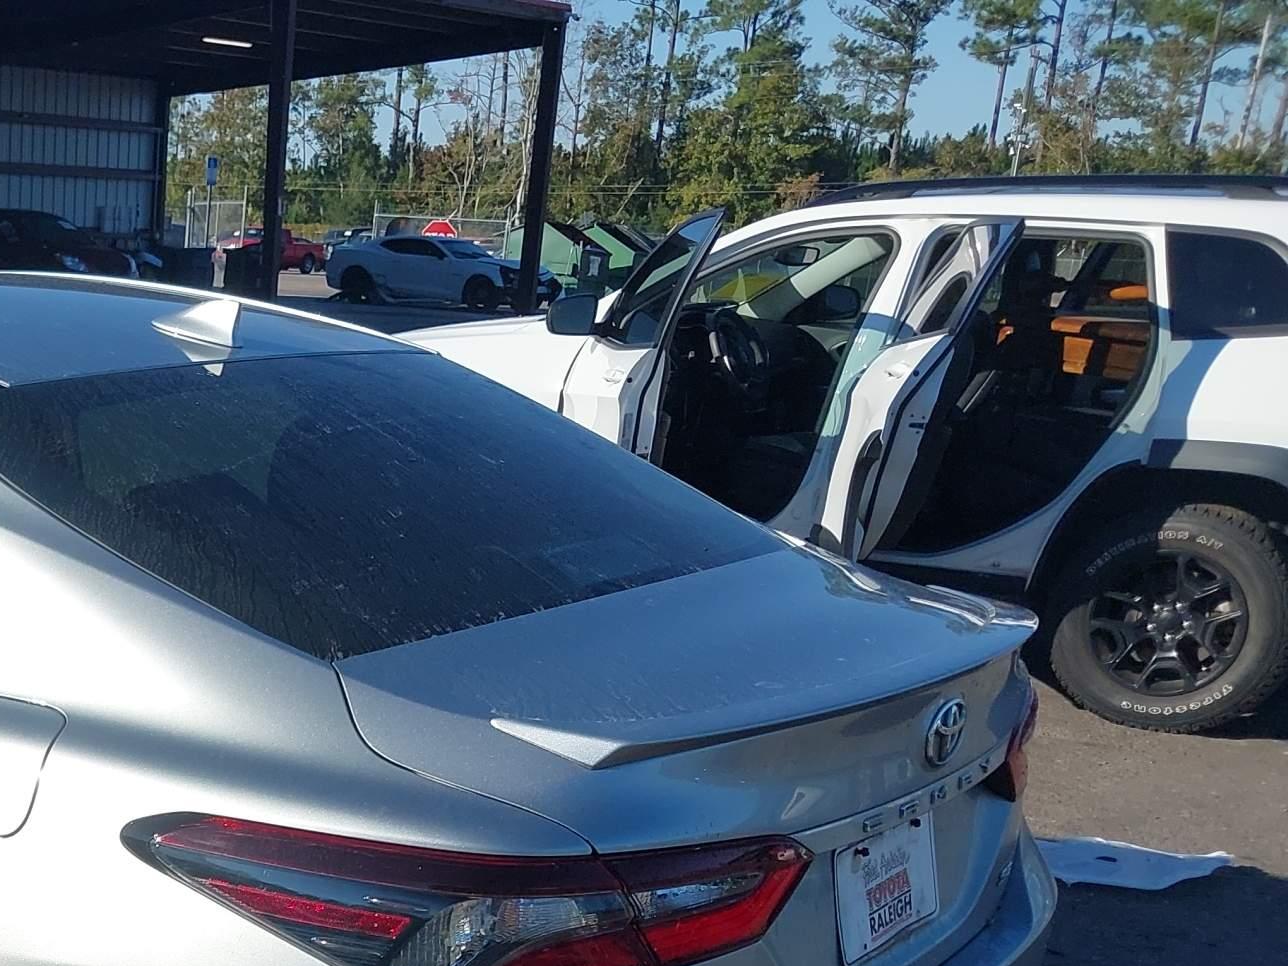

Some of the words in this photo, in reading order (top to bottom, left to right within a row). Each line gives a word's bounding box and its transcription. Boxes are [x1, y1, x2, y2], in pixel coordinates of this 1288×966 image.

[1085, 530, 1189, 577] DESTINAION
[865, 868, 911, 909] TOYOTA
[869, 893, 912, 937] RALEIGH
